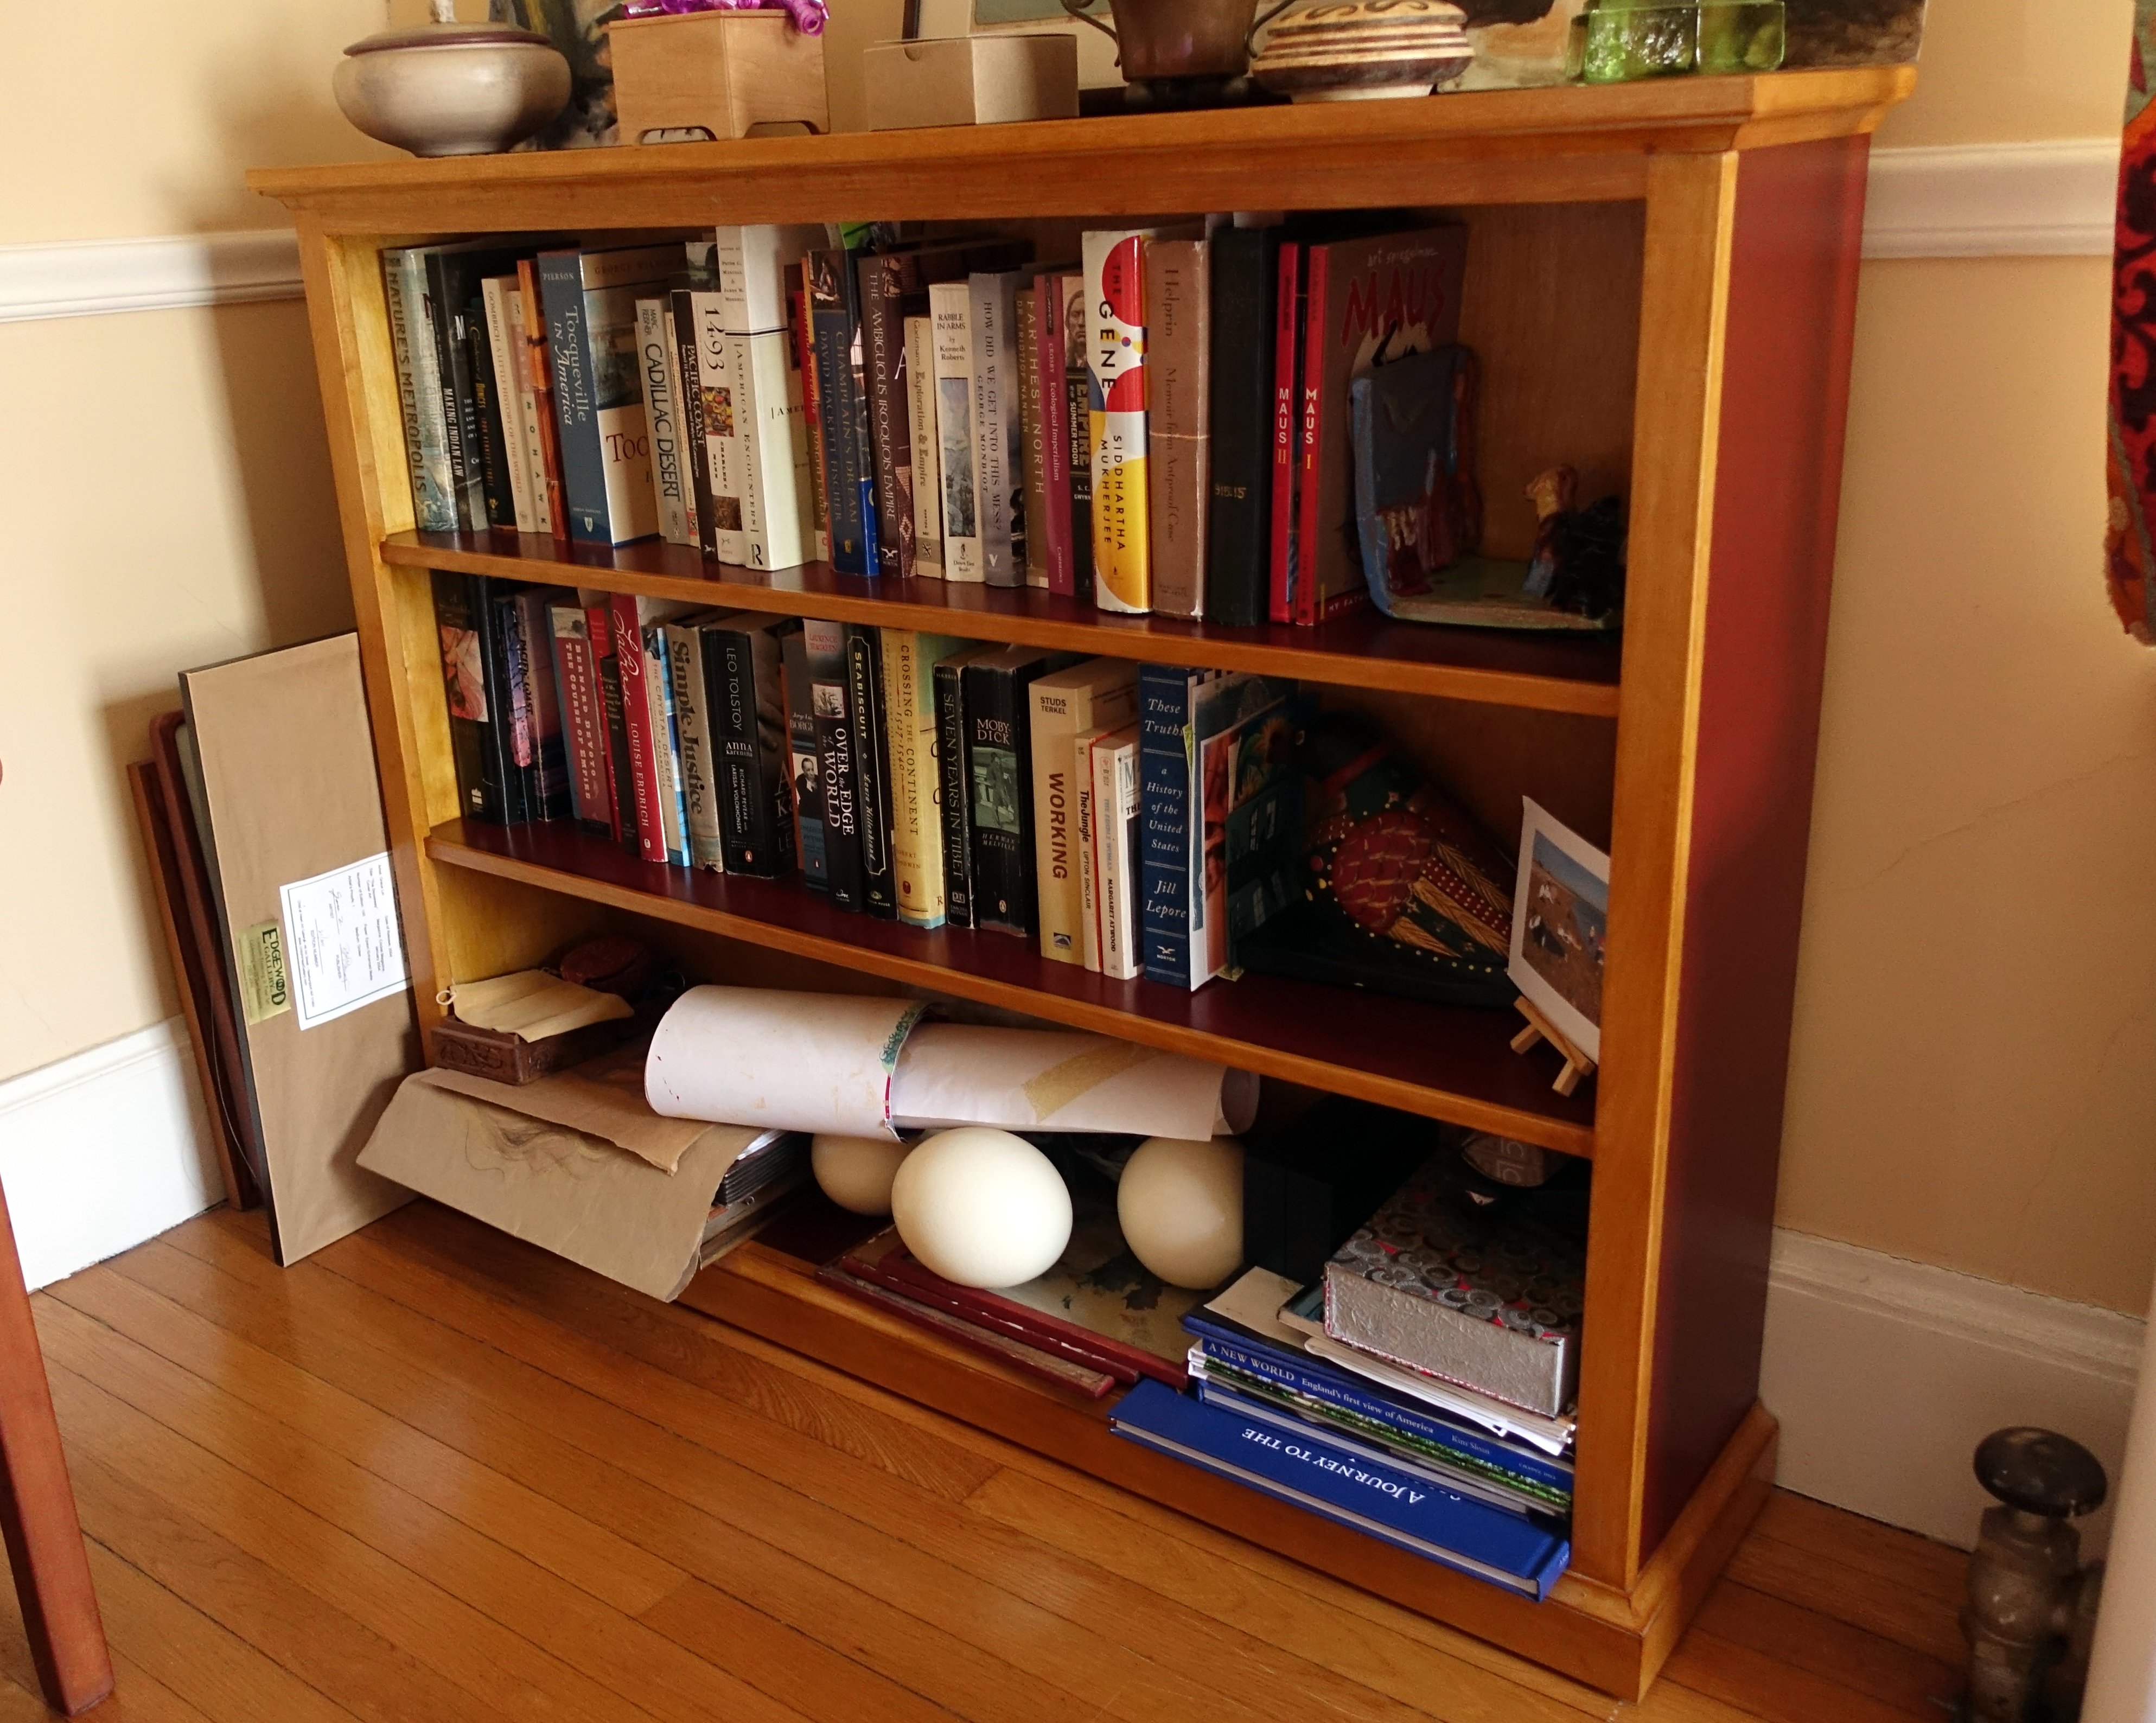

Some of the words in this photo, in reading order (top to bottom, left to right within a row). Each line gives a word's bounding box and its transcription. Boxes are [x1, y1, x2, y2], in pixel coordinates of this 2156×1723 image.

[869, 272, 879, 300] THE
[1112, 265, 1121, 295] THE
[937, 322, 944, 330] IN
[945, 322, 965, 330] ARMS
[938, 313, 964, 321] RABBLE
[984, 302, 993, 329] HOW
[1341, 259, 1447, 349] MAUS
[554, 321, 563, 340] IN
[704, 307, 725, 370] 1493
[872, 307, 888, 395] AMBIGUOUS
[914, 320, 922, 366] Goetzmann
[985, 336, 994, 357] DID
[1099, 301, 1116, 389] GENE
[489, 291, 500, 341] GOMBRICH
[501, 387, 513, 424] HISTORY
[565, 305, 590, 422] Tocqueville
[687, 344, 700, 398] PACIFIC
[820, 331, 831, 377] DAVID
[987, 366, 996, 385] WE
[1026, 301, 1041, 413] FARTHEST
[443, 388, 457, 423] MAKING
[554, 346, 572, 425] America
[645, 343, 672, 432] CADILLAC
[736, 350, 748, 424] AMERICAN
[914, 371, 926, 431] Exploration
[977, 375, 985, 427] GEORGE
[987, 390, 997, 414] GET
[1049, 382, 1059, 426] Ecological
[401, 372, 426, 493] METROPOLIS
[693, 401, 705, 447] COAST
[824, 384, 837, 451] HACKETT
[835, 331, 852, 454] CHAMPLAIN'S
[846, 461, 858, 523] DREAM
[878, 399, 892, 470] IROQUOIS
[988, 423, 998, 451] INTO
[1070, 402, 1078, 438] SUMMER
[1278, 387, 1290, 444] MAUS
[1305, 387, 1318, 444] MAUS
[448, 425, 461, 456] INDIAN
[918, 435, 928, 445] &
[1032, 423, 1044, 493] NORTH
[1051, 429, 1060, 481] Imperialism
[452, 458, 464, 477] LAW
[656, 438, 681, 502] DESERT
[918, 448, 928, 487] Empire
[980, 434, 988, 493] MONBIOT
[990, 456, 1000, 486] THIS
[831, 460, 841, 521] FISCHER
[884, 475, 895, 521] EMPIRE
[992, 493, 1002, 530] MESS?
[1101, 439, 1112, 544] MUKHERJEE
[1113, 435, 1126, 551] SIDDHARTHA
[520, 640, 530, 679] PACIFIC
[565, 642, 574, 669] THE
[613, 610, 640, 710] LaRose
[726, 647, 738, 672] LEO
[522, 682, 533, 715] COAST
[570, 673, 581, 724] COURSE
[673, 641, 696, 726] Simple
[729, 677, 743, 731] TOLSTOY
[854, 652, 867, 739] SEABISCUIT
[901, 645, 913, 717] CROSSING
[1040, 696, 1067, 707] STUDS
[943, 693, 956, 749] SEVEN
[1041, 705, 1067, 715] TERKEL
[1144, 719, 1184, 737] Truths
[1148, 698, 1181, 714] These
[577, 729, 584, 744] OF
[630, 723, 643, 767] LOUISE
[655, 685, 666, 738] CRYSTAL
[662, 744, 673, 790] DESERT
[726, 742, 753, 752] Anna
[834, 728, 849, 773] OVER
[978, 729, 1010, 745] DICK
[579, 750, 591, 799] EMPIRE
[683, 730, 705, 814] Justice
[824, 750, 840, 827] WORLD
[863, 774, 872, 802] Laura
[905, 748, 918, 836] CONTINENT
[946, 755, 960, 808] YEARS
[1146, 781, 1183, 800] History
[1161, 767, 1168, 775] a
[636, 771, 650, 827] ERDRICH
[734, 790, 742, 834] VOLOKHONSKY
[839, 789, 854, 835] EDGE
[951, 812, 961, 829] IN
[1151, 802, 1163, 815] of
[1164, 804, 1179, 815] the
[865, 806, 876, 861] Hillenbrand
[1049, 772, 1068, 879] WORKING
[1149, 819, 1183, 834] United
[1151, 838, 1180, 853] States
[952, 834, 964, 880] TIBET
[1145, 899, 1187, 918] Lepore
[1153, 880, 1177, 895] Jill
[261, 927, 286, 1006] EDGEWOOD
[264, 946, 276, 989] GALLERY
[1209, 1342, 1217, 1352] A
[1220, 1346, 1247, 1363] NEW
[1251, 1357, 1295, 1381] WORLD
[1302, 1378, 1341, 1399] England's
[1343, 1393, 1361, 1407] first
[1362, 1401, 1383, 1415] view
[1396, 1414, 1434, 1434] America
[1241, 1428, 1283, 1451] THE
[1285, 1445, 1312, 1462] TO
[1313, 1456, 1408, 1498] JOURNEY
[1409, 1490, 1426, 1504] A
